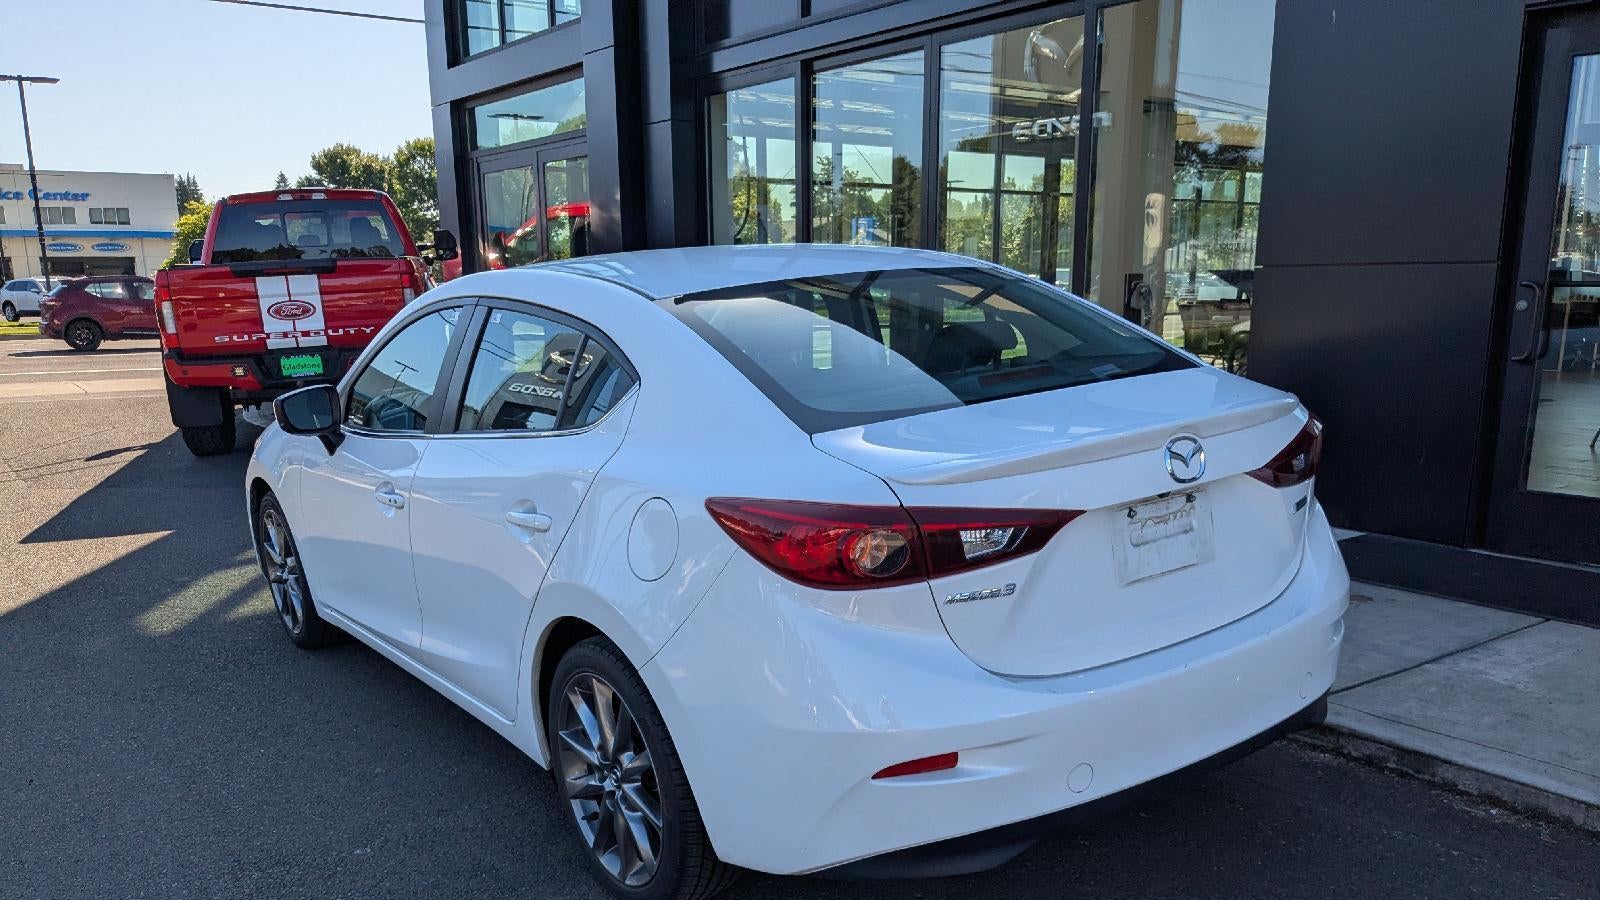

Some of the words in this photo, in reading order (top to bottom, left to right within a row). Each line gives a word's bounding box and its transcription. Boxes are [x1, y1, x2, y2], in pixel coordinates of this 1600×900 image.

[28, 188, 90, 201] Center
[280, 305, 303, 316] Ford
[214, 331, 302, 343] SUPER
[309, 326, 375, 337] DUTY
[282, 361, 321, 371] Gladstone
